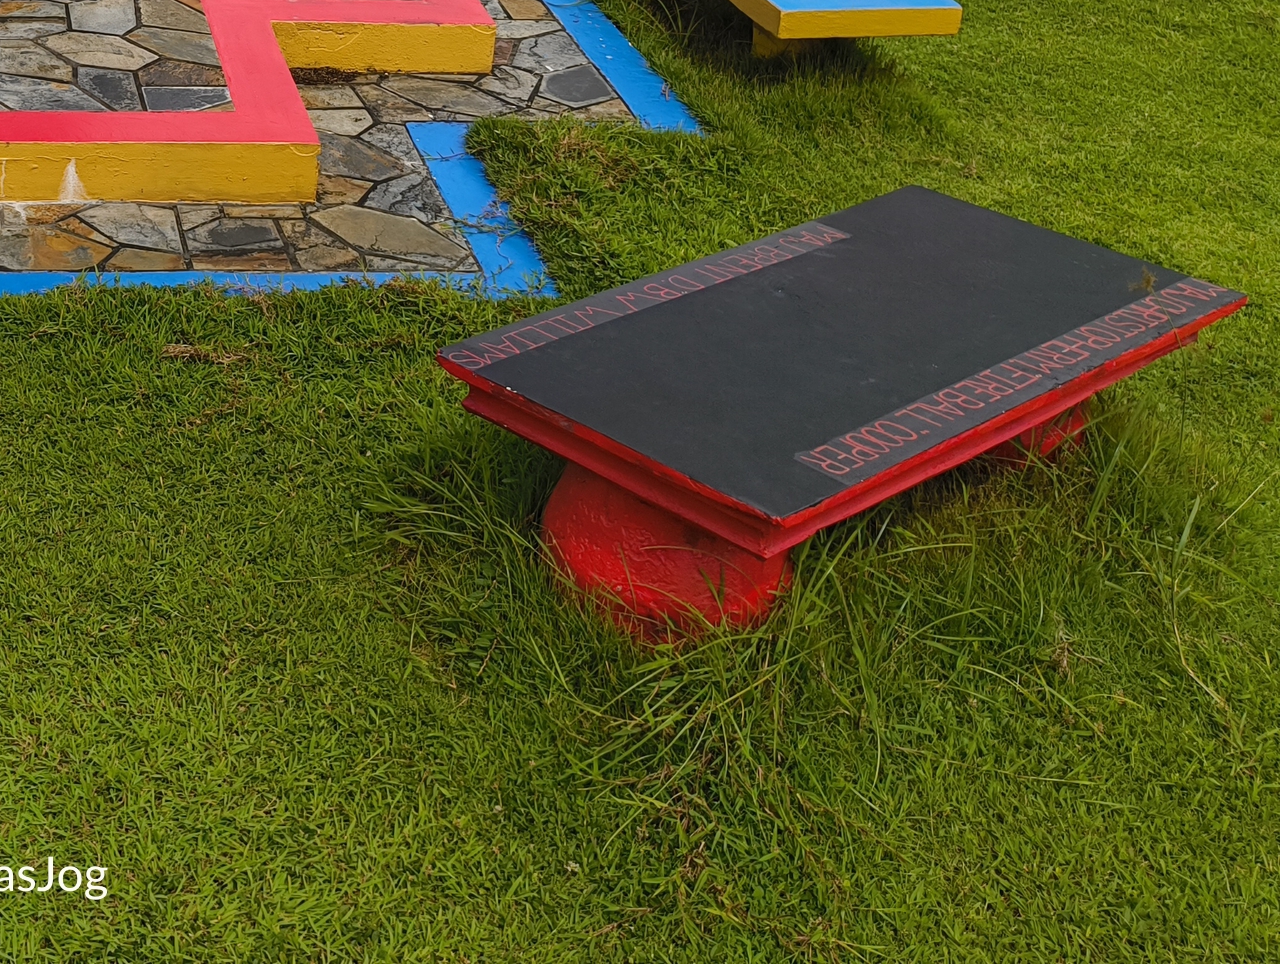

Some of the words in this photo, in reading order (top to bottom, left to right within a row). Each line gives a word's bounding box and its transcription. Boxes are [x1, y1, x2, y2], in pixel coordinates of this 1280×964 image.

[779, 224, 847, 254] MAJ
[705, 244, 793, 284] BRENT
[446, 305, 623, 370] WILLIAMS
[800, 419, 918, 474] COOPER
